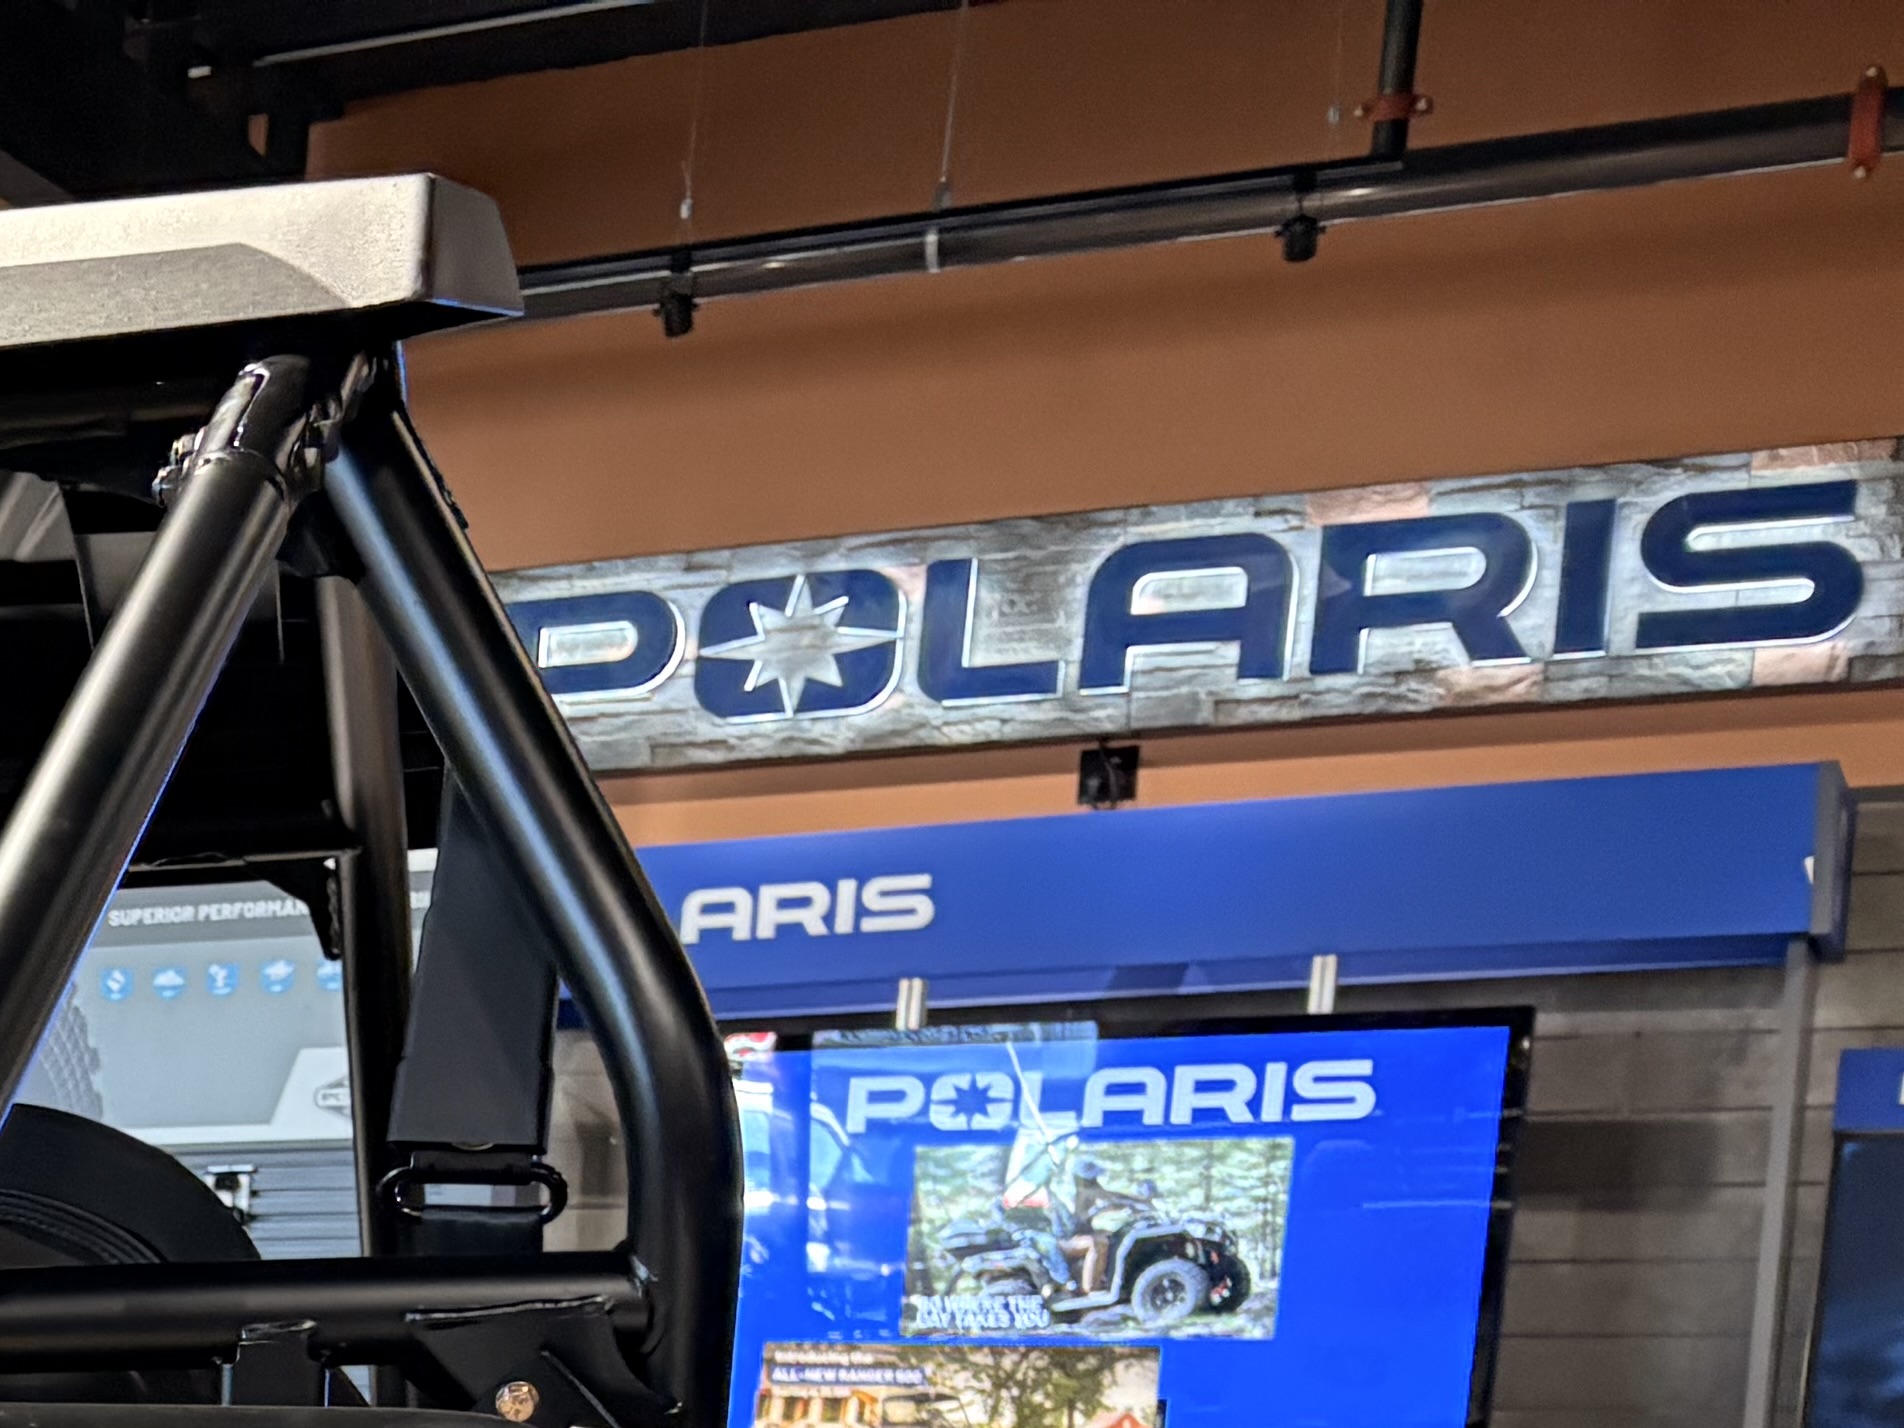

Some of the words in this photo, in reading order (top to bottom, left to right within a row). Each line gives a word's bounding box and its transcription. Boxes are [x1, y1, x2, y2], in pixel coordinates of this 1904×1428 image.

[514, 480, 1866, 722] POLARIS
[107, 903, 194, 927] SUPERIOR
[197, 897, 309, 921] PERFORMAN
[679, 873, 935, 945] ARIS
[846, 1058, 1378, 1135] POLARIS
